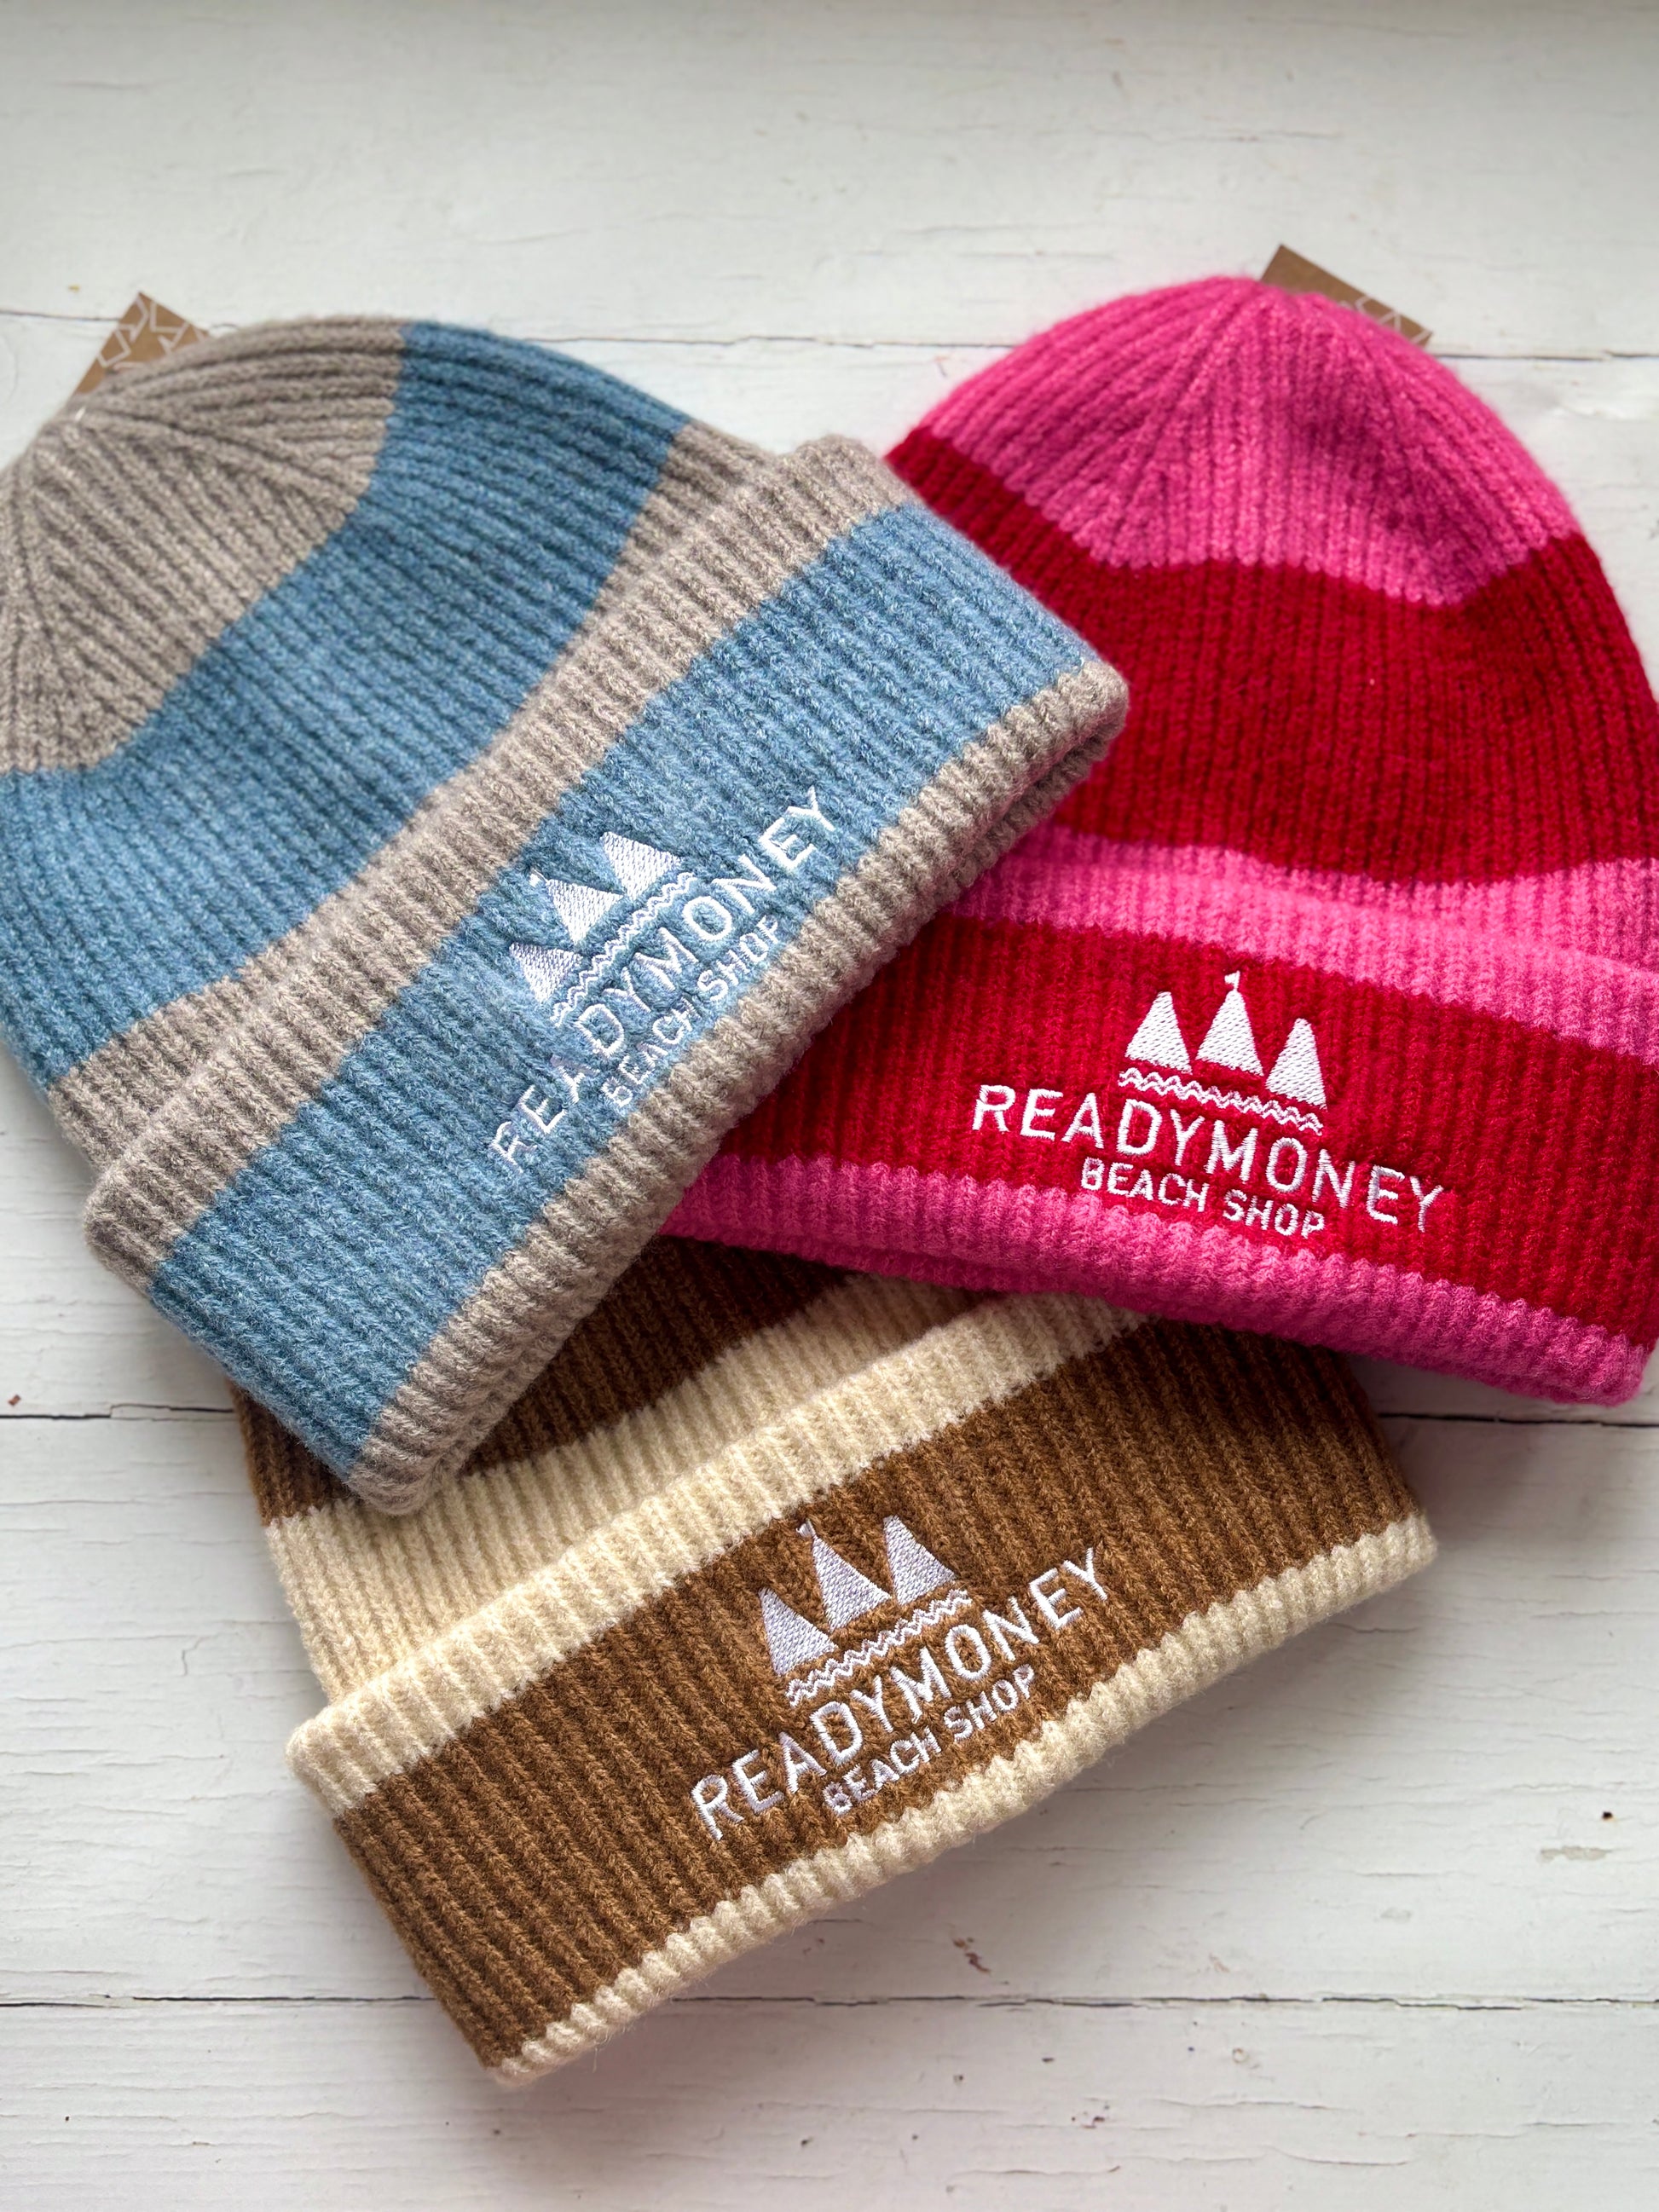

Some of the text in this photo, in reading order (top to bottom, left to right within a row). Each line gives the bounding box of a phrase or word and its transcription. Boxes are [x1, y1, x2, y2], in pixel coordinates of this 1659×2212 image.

[490, 786, 835, 1173] READYMONEY
[601, 915, 781, 1107] BEACH SHOP
[973, 1084, 1443, 1232] READYMONEY
[1080, 1157, 1325, 1239] BEACH SHOP
[691, 1547, 1107, 1840] READYMONEY
[824, 1664, 1034, 1816] BEACH SHOP
